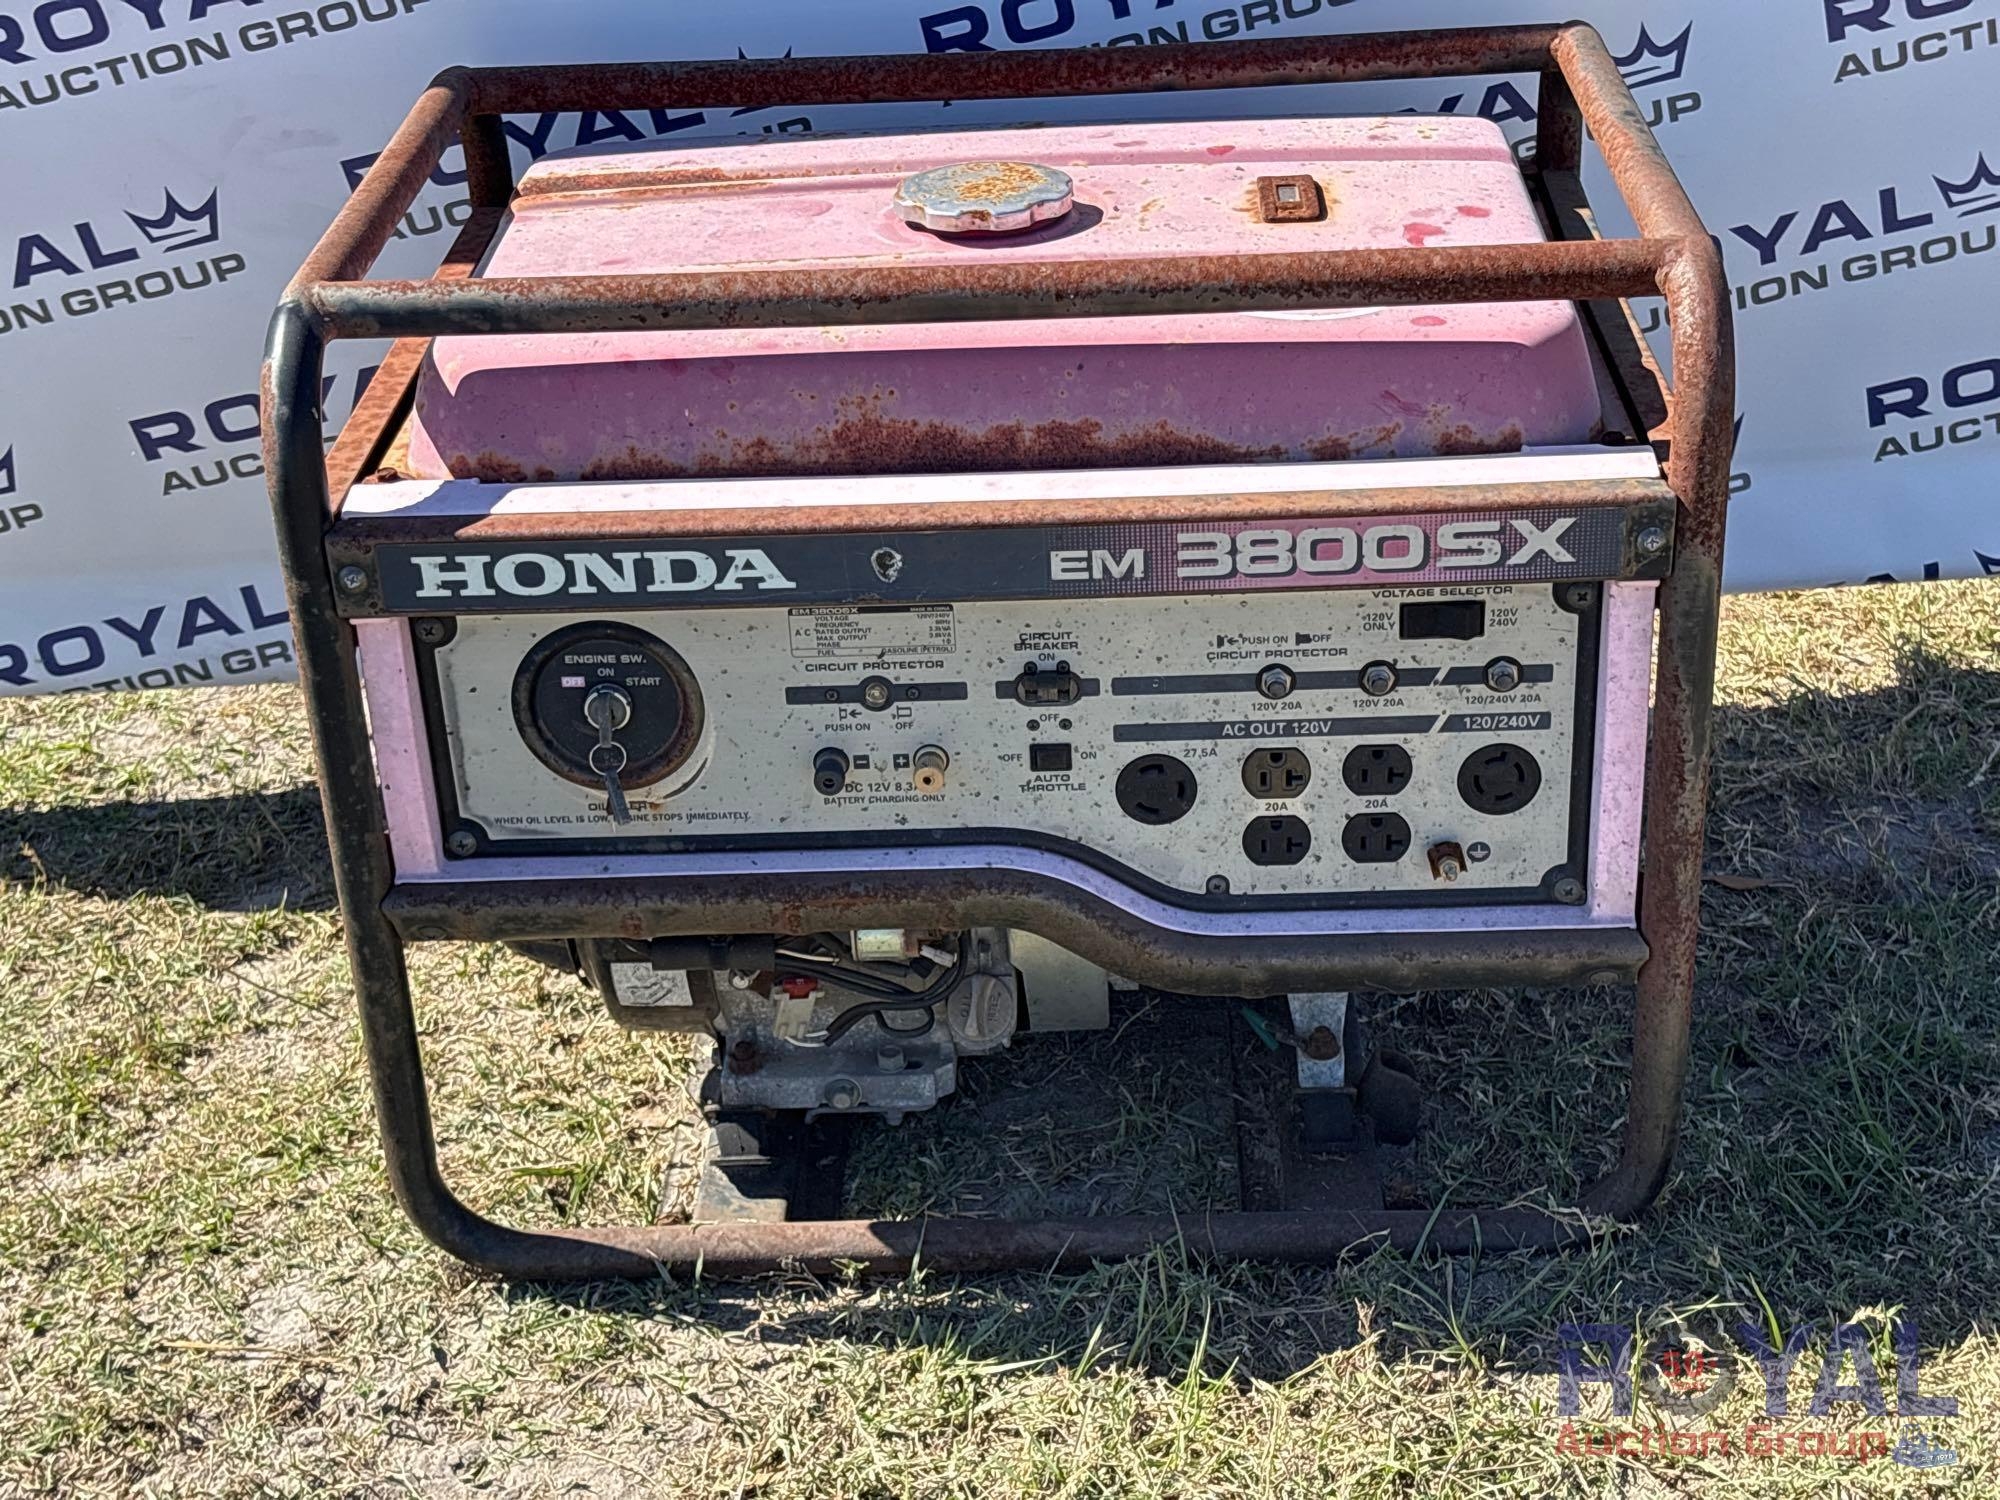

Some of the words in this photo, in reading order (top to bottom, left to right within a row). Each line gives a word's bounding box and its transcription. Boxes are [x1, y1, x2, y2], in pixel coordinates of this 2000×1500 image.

[0, 32, 231, 109] AUCTION
[13, 221, 141, 289] AL
[60, 253, 246, 317] GROUP
[1050, 548, 1146, 581] EM
[1177, 517, 1577, 580] 3800SX
[410, 548, 797, 598] HONDA
[1372, 588, 1435, 598] VOLTAGE
[1439, 585, 1513, 597] SELECTOR
[1365, 612, 1393, 622] 120V
[1490, 608, 1518, 617] 120V
[1363, 622, 1396, 631] ONLY
[1489, 617, 1518, 627] 240V
[1019, 632, 1073, 641] CIRCUIT
[1242, 636, 1271, 644] PUSH
[1273, 635, 1288, 643] ON
[1312, 633, 1332, 643] OFF
[1014, 641, 1078, 651] BREAKER
[564, 655, 617, 664] ENGINE
[620, 654, 647, 663] SW.
[1038, 653, 1055, 661] ON
[1206, 650, 1261, 661] CIRCUIT
[1265, 647, 1348, 658] PROTECTOR
[805, 662, 858, 672] CIRCUIT
[862, 660, 944, 671] PROTECTOR
[597, 667, 615, 677] ON
[625, 677, 661, 686] START
[1353, 699, 1379, 708] 120V
[1383, 698, 1404, 707] 20A
[1465, 694, 1517, 705] 120/240V
[1520, 693, 1541, 703] 20A
[1251, 702, 1279, 712] 120V
[1281, 701, 1302, 711] 20A
[1040, 713, 1060, 722] OFF
[1464, 714, 1540, 729] 120/240V
[825, 723, 852, 732] PUSH
[855, 723, 871, 731] ON
[895, 722, 914, 730] OFF
[1222, 724, 1245, 736] AC
[1249, 722, 1286, 735] OUT
[1291, 721, 1332, 734] 120V
[1002, 753, 1023, 762] OFF
[1080, 751, 1097, 760] ON
[1034, 774, 1071, 783] AUTO
[845, 783, 864, 793] DC
[867, 782, 891, 792] 12V
[1018, 782, 1087, 793] THROTTLE
[823, 796, 866, 806] BATTERY
[868, 795, 920, 804] CHARGING
[921, 794, 946, 803] ONLY
[1364, 799, 1389, 809] 20A
[1265, 802, 1289, 812] 20A
[494, 817, 524, 826] WHEN
[526, 816, 542, 825] OIL
[544, 816, 572, 824] LEVEL
[575, 815, 585, 824] IS
[652, 812, 683, 822] STOPS
